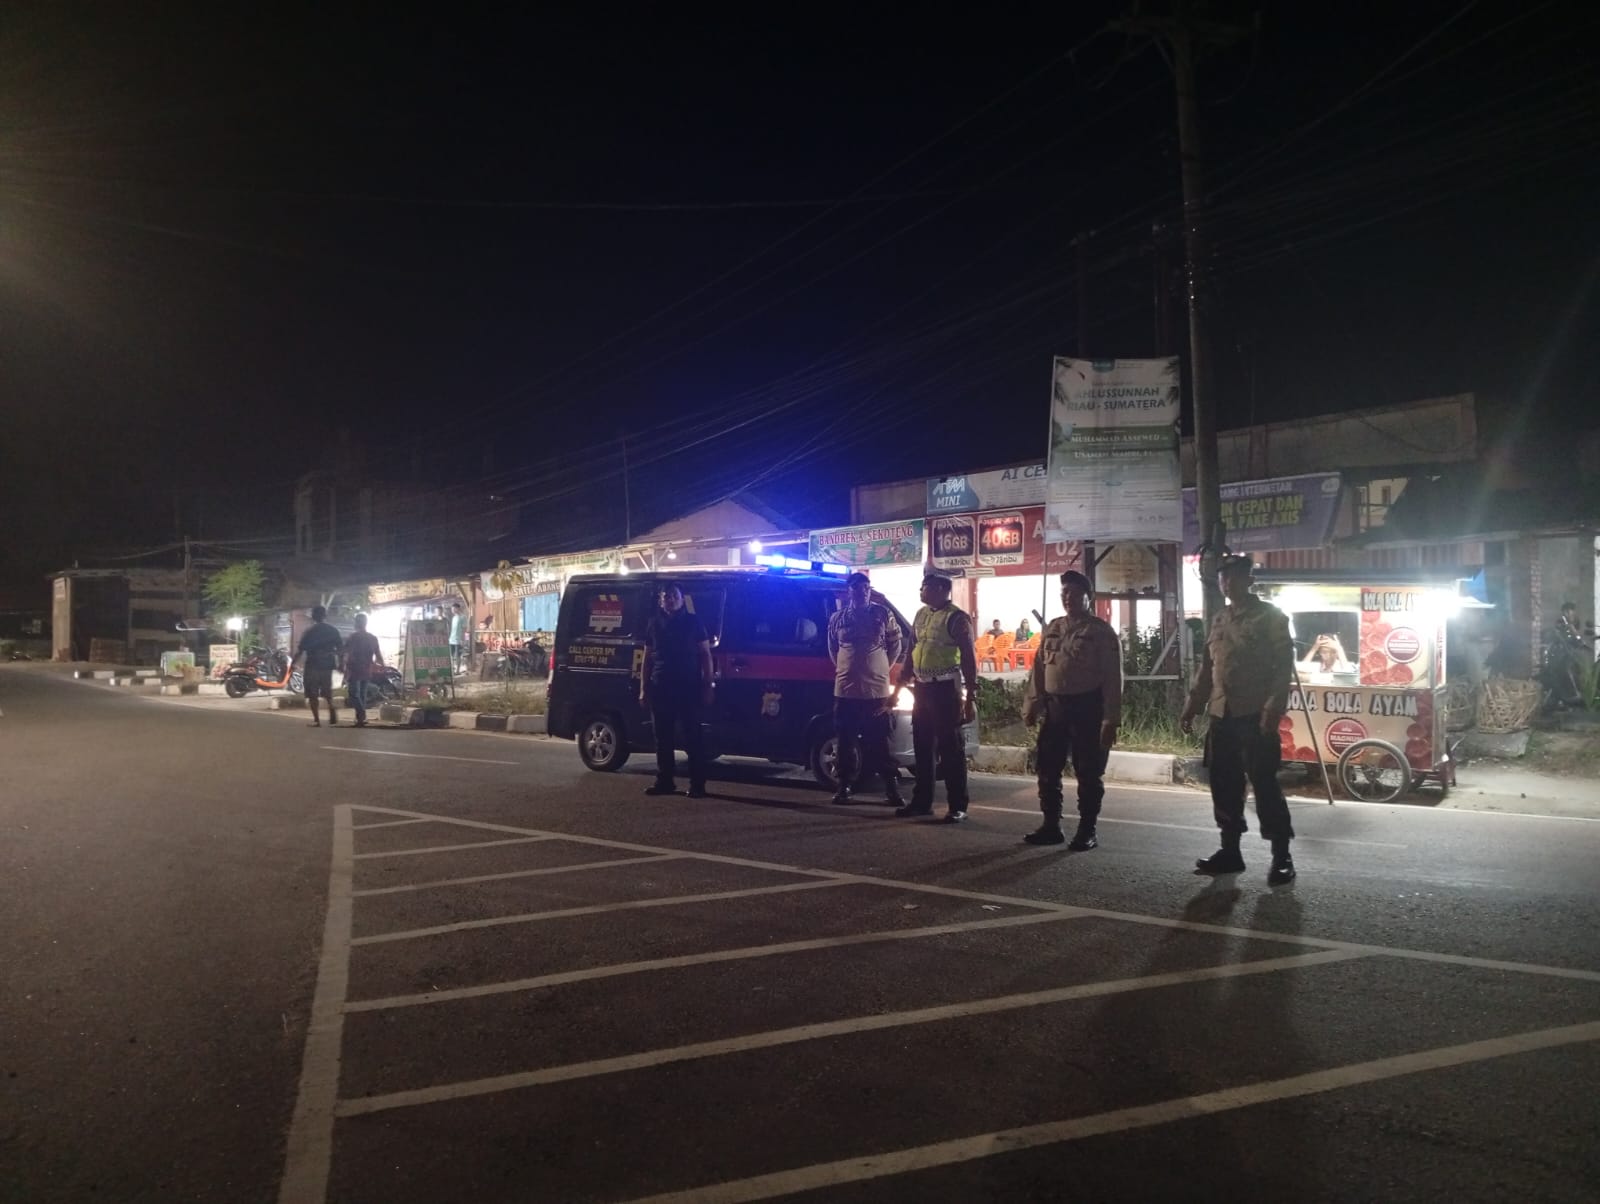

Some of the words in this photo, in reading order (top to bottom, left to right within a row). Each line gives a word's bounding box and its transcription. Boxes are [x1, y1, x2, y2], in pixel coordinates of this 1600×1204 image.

[1104, 398, 1166, 410] SUMATERA
[936, 495, 961, 508] MINI
[1236, 498, 1273, 515] CEPAT
[1276, 495, 1304, 510] DAN
[1237, 513, 1269, 529] PAKE
[1272, 510, 1299, 525] AXIS
[867, 525, 913, 541] SEKOTENG
[937, 532, 969, 551] 16GB
[981, 527, 1020, 549] 40GB
[582, 646, 603, 655] CENTER
[1325, 691, 1362, 713] BOLA
[1370, 694, 1418, 717] AYAM
